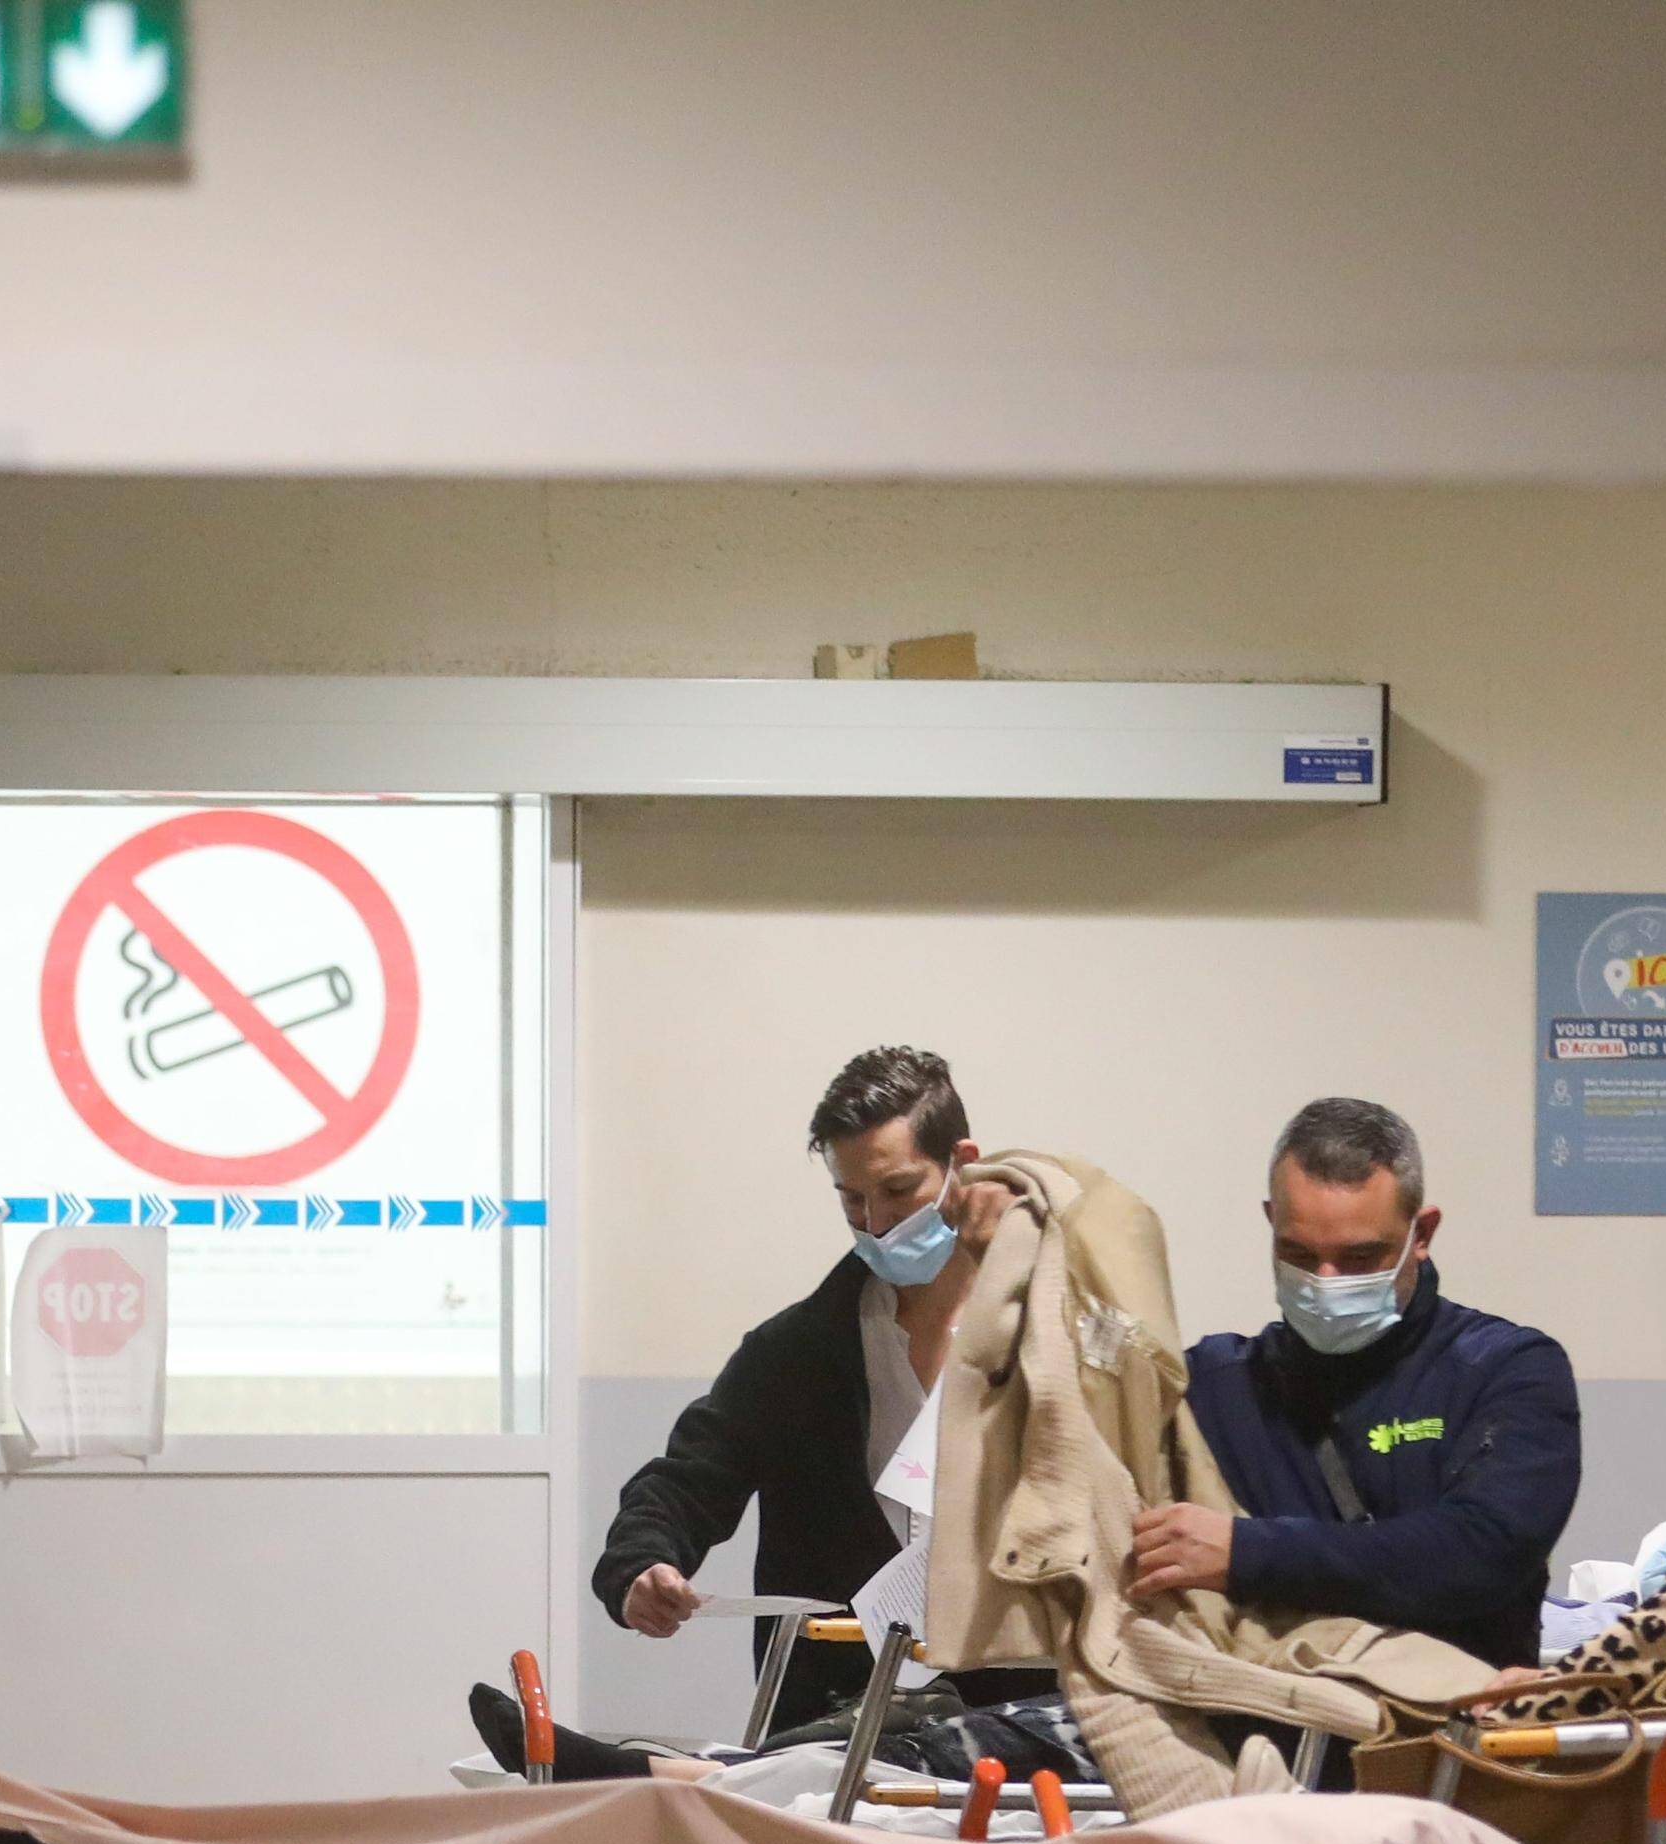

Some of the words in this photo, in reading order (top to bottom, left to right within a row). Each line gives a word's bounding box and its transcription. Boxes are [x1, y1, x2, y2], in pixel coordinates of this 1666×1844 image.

[1555, 1023, 1595, 1037] VOUS
[1599, 1020, 1638, 1037] ÊTES
[1628, 1041, 1658, 1055] DES
